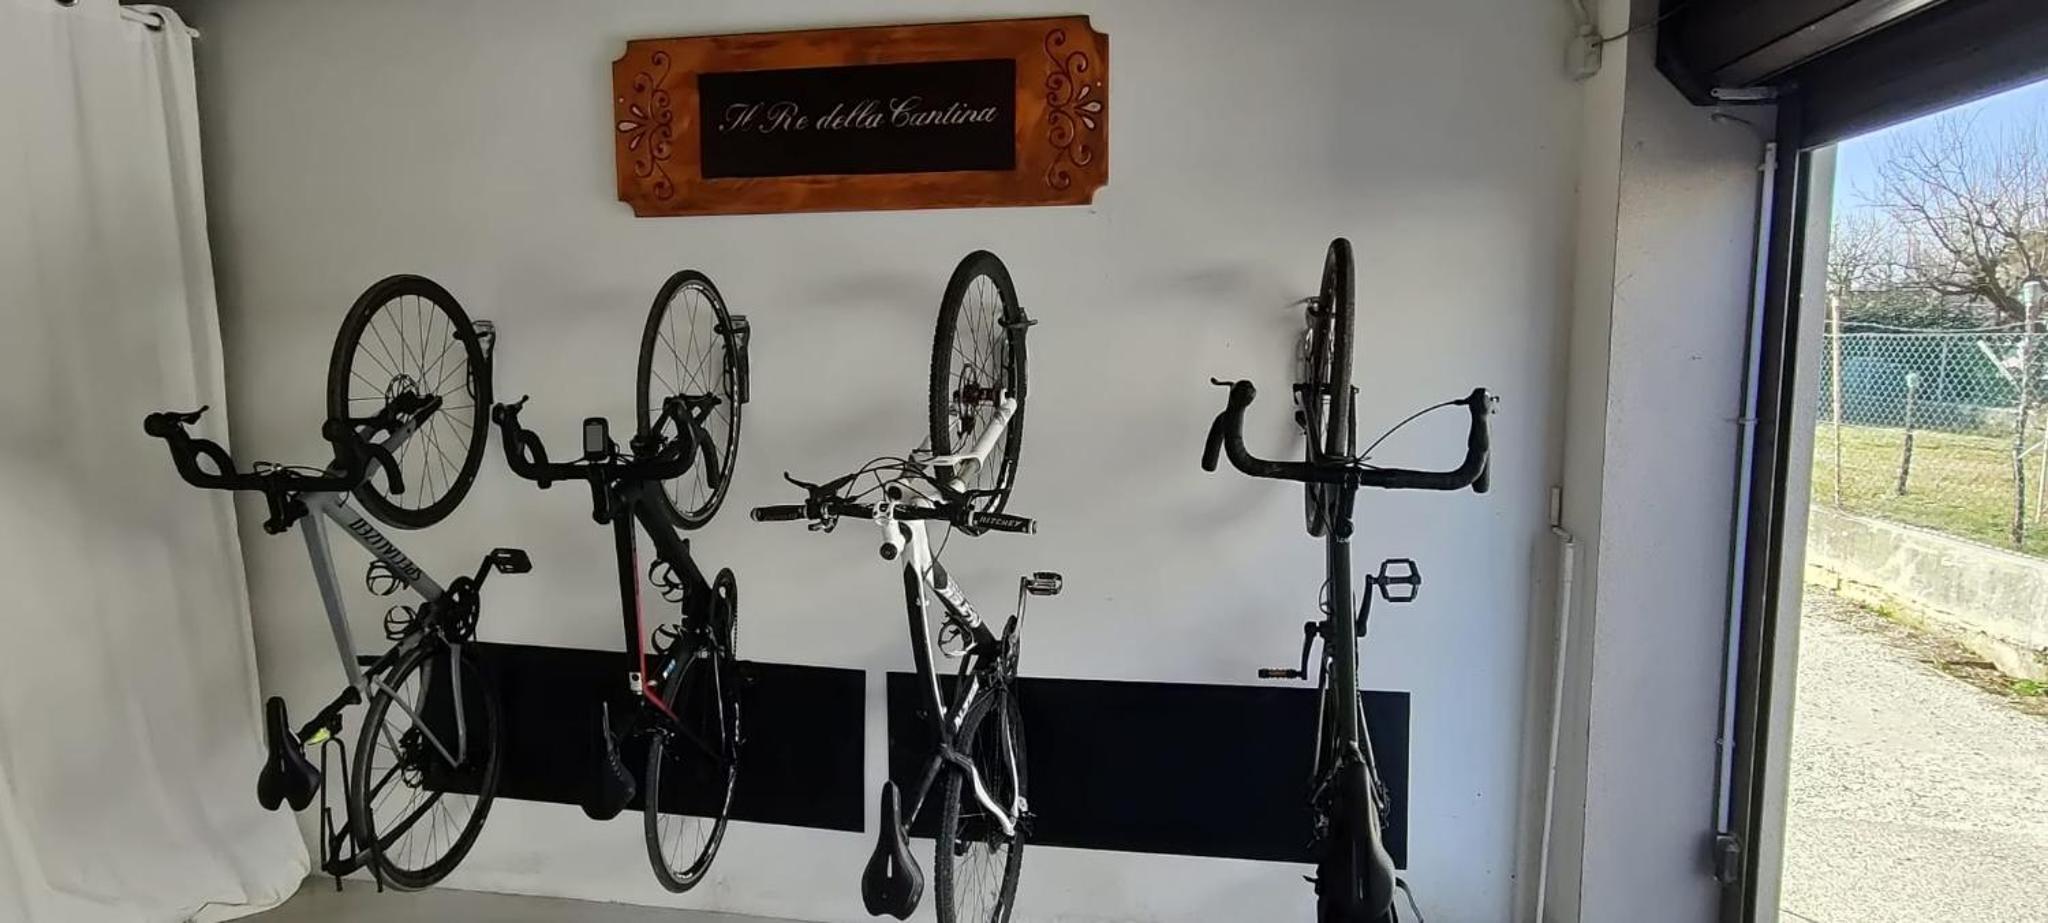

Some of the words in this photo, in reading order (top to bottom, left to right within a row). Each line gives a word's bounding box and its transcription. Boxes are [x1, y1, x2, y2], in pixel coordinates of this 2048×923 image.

[719, 102, 763, 132] Il
[758, 101, 809, 133] Re
[815, 100, 884, 131] della
[889, 96, 999, 128] Cantina
